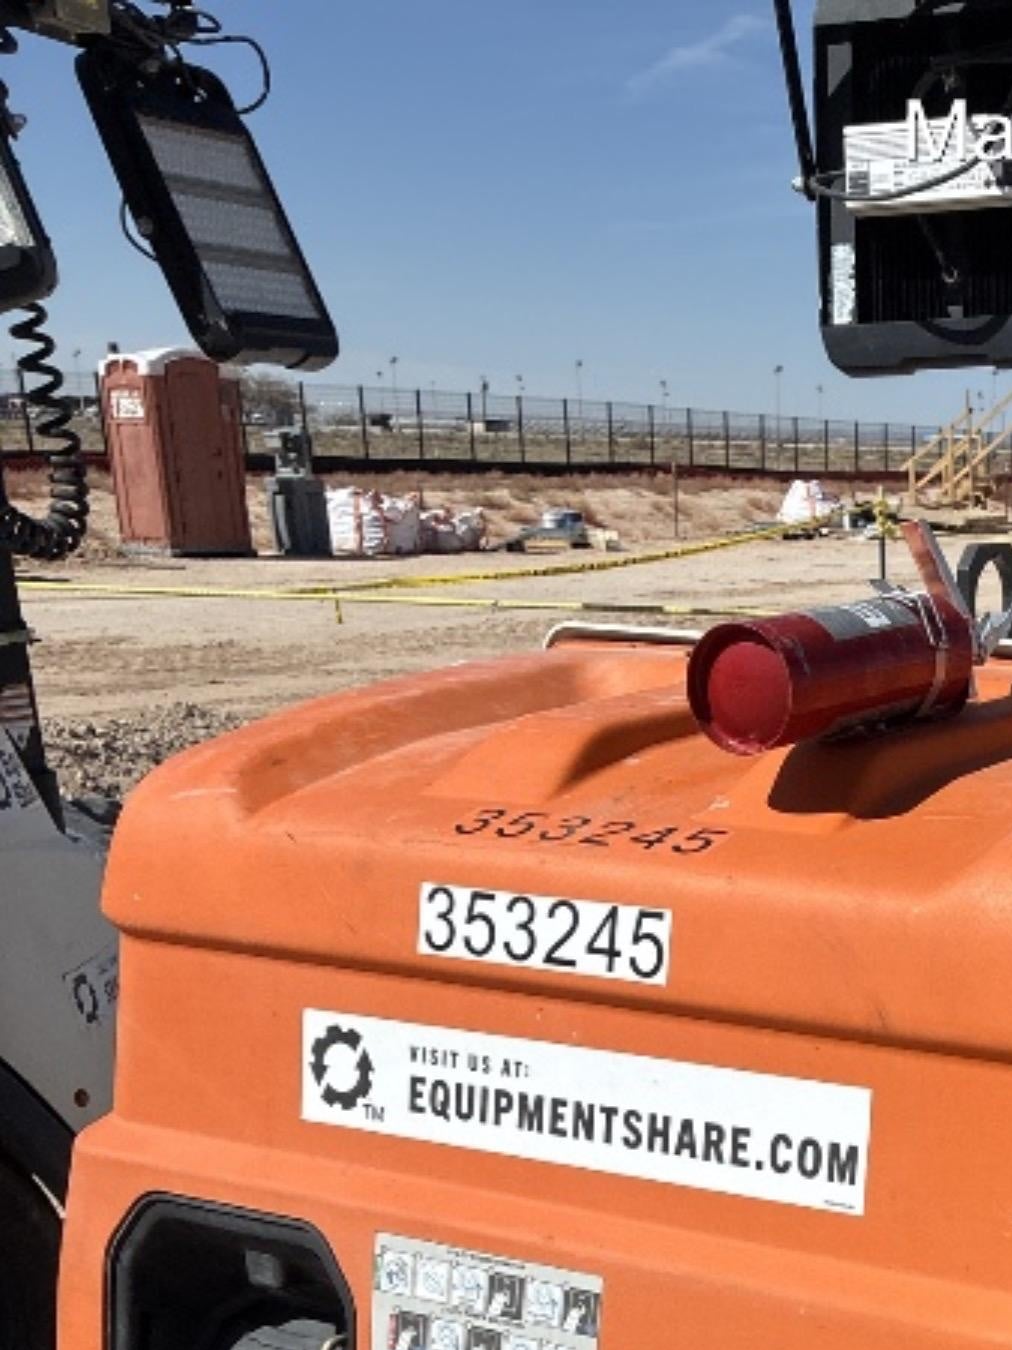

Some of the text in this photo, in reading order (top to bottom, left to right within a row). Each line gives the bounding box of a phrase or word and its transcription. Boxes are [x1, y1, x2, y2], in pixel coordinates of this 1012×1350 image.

[454, 808, 729, 854] 353245
[424, 886, 665, 979] 353245
[410, 1046, 531, 1080] VISIT US AT:
[408, 1075, 860, 1187] EQUIPMENTSHARE.COM
